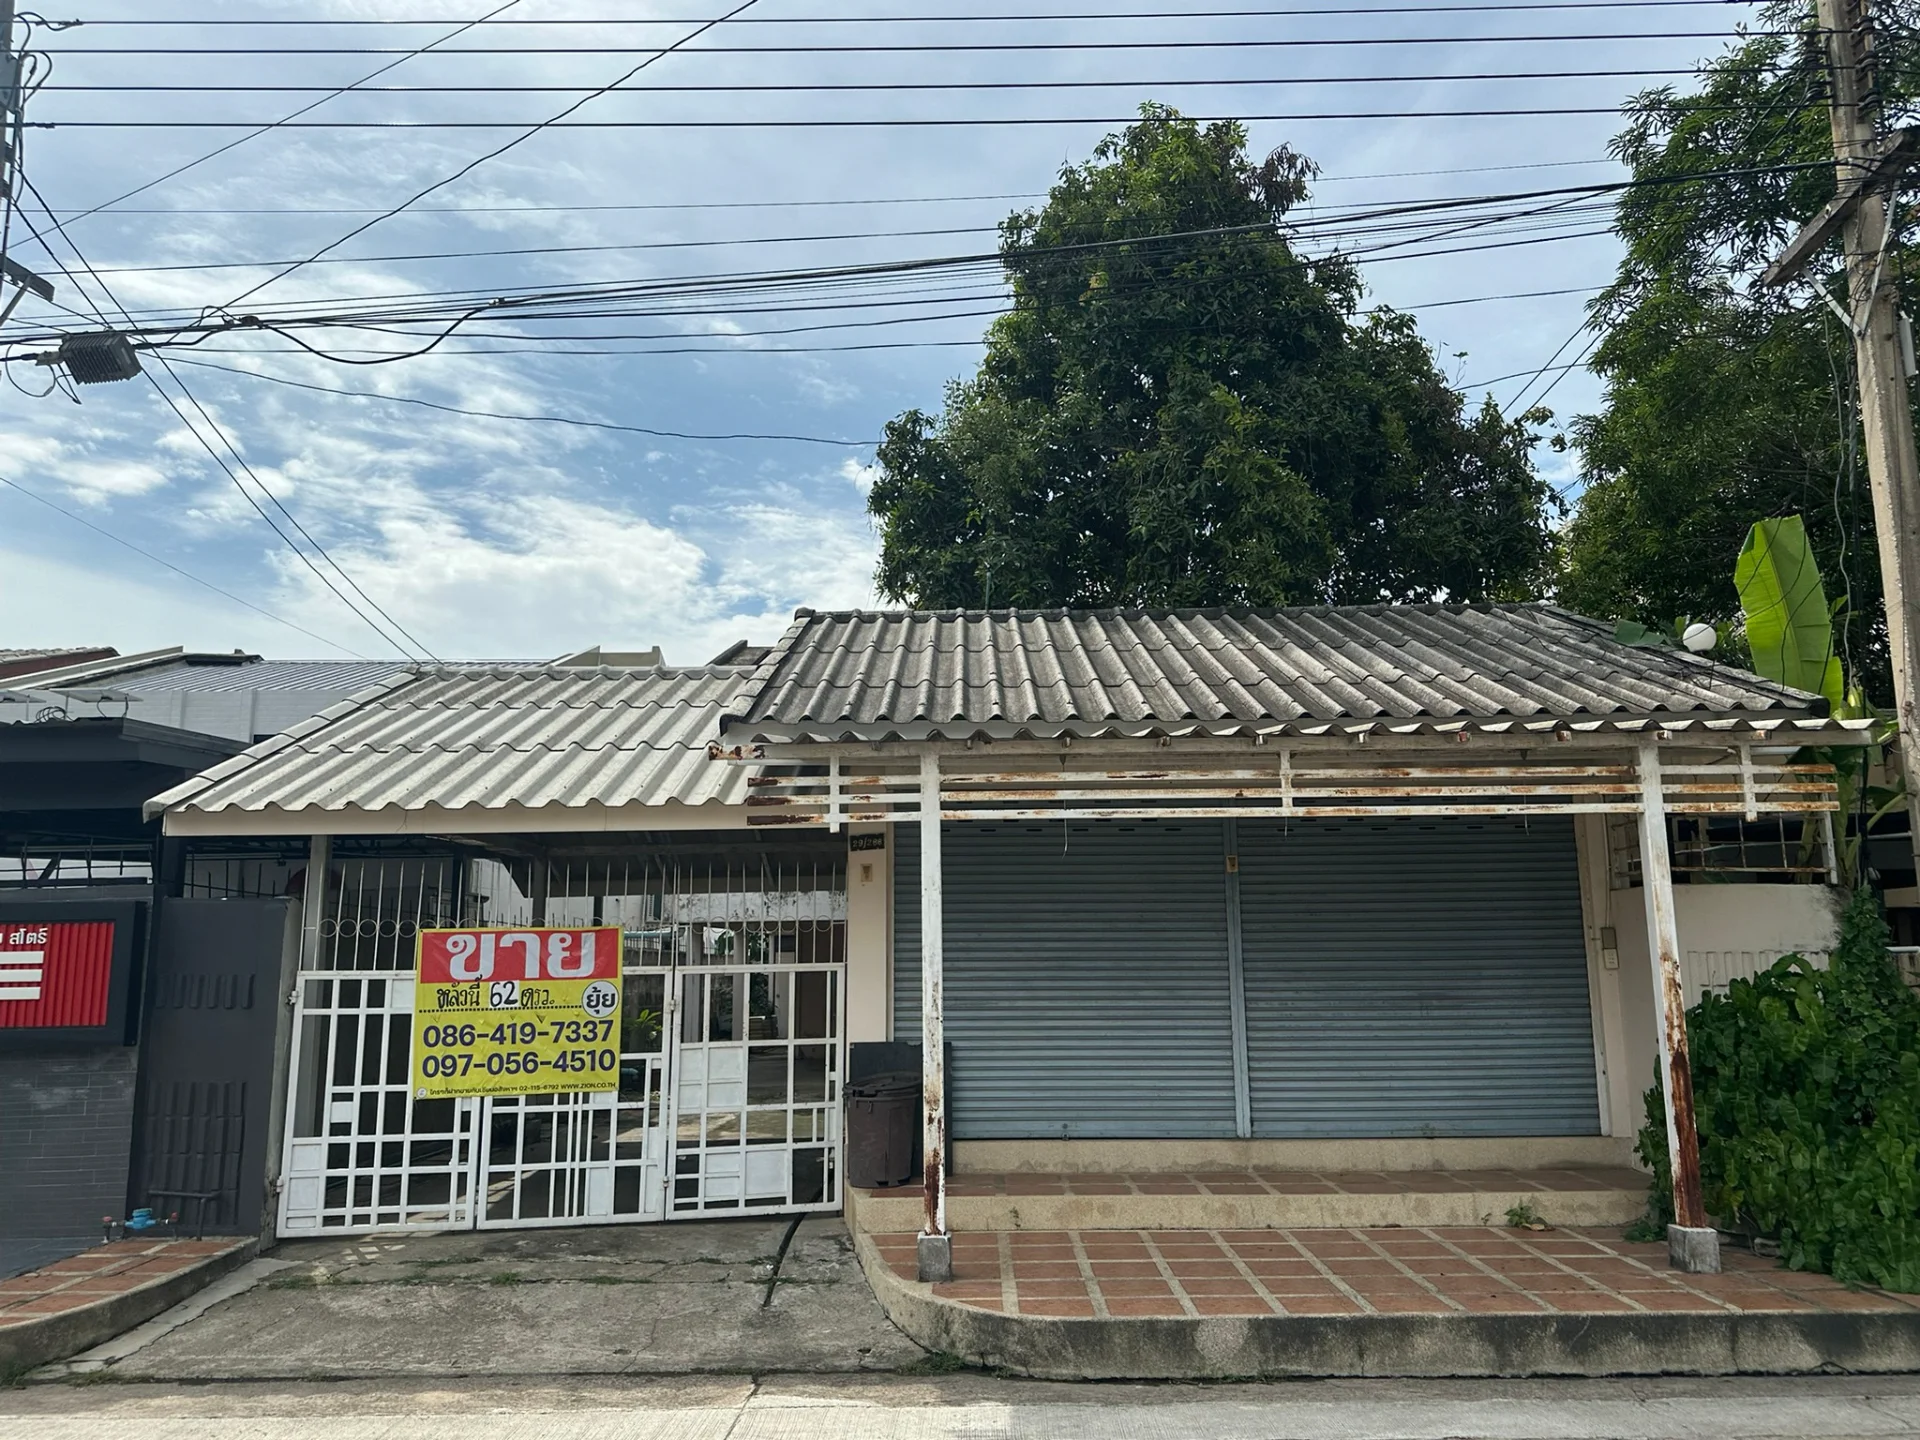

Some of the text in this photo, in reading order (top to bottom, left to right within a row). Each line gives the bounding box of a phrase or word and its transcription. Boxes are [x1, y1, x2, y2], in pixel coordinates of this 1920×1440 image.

[9, 928, 48, 945] สโตร์
[446, 932, 596, 981] ขาย
[490, 980, 518, 1007] 62
[586, 986, 616, 1015] ยุ้ย
[423, 1020, 614, 1048] 086-419-7337
[422, 1048, 616, 1078] 097-056-4510
